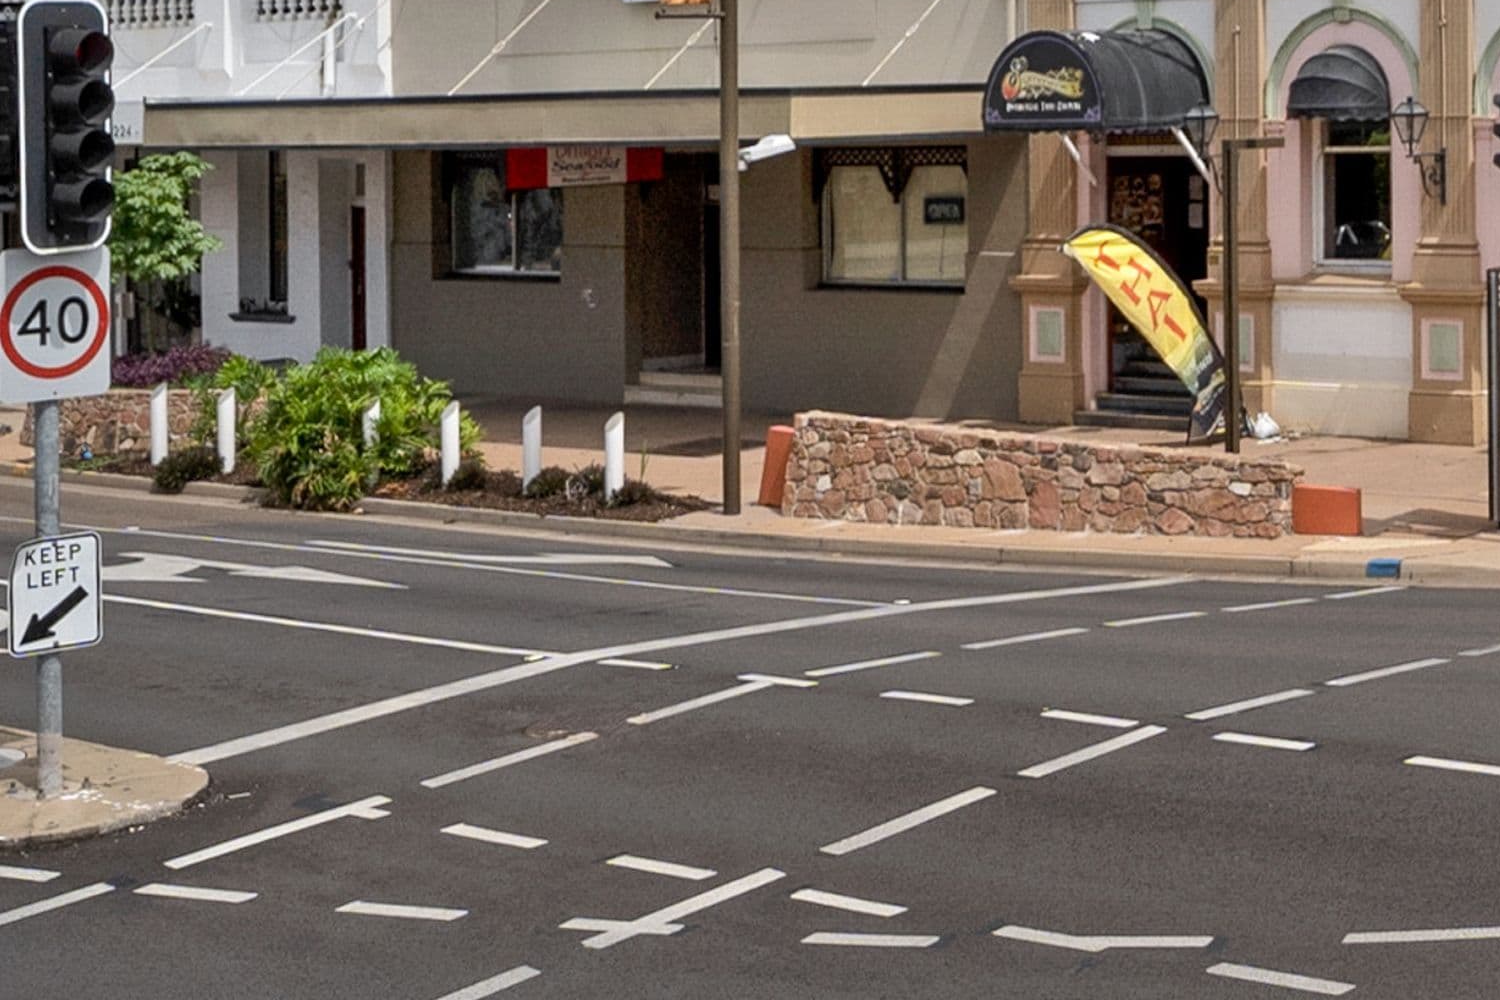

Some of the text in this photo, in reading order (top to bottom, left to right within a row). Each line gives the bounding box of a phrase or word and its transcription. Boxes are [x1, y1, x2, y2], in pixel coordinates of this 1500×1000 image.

[1093, 239, 1187, 342] THAI
[17, 296, 90, 347] 40
[24, 543, 82, 567] KEEP
[27, 566, 80, 589] LEFT
